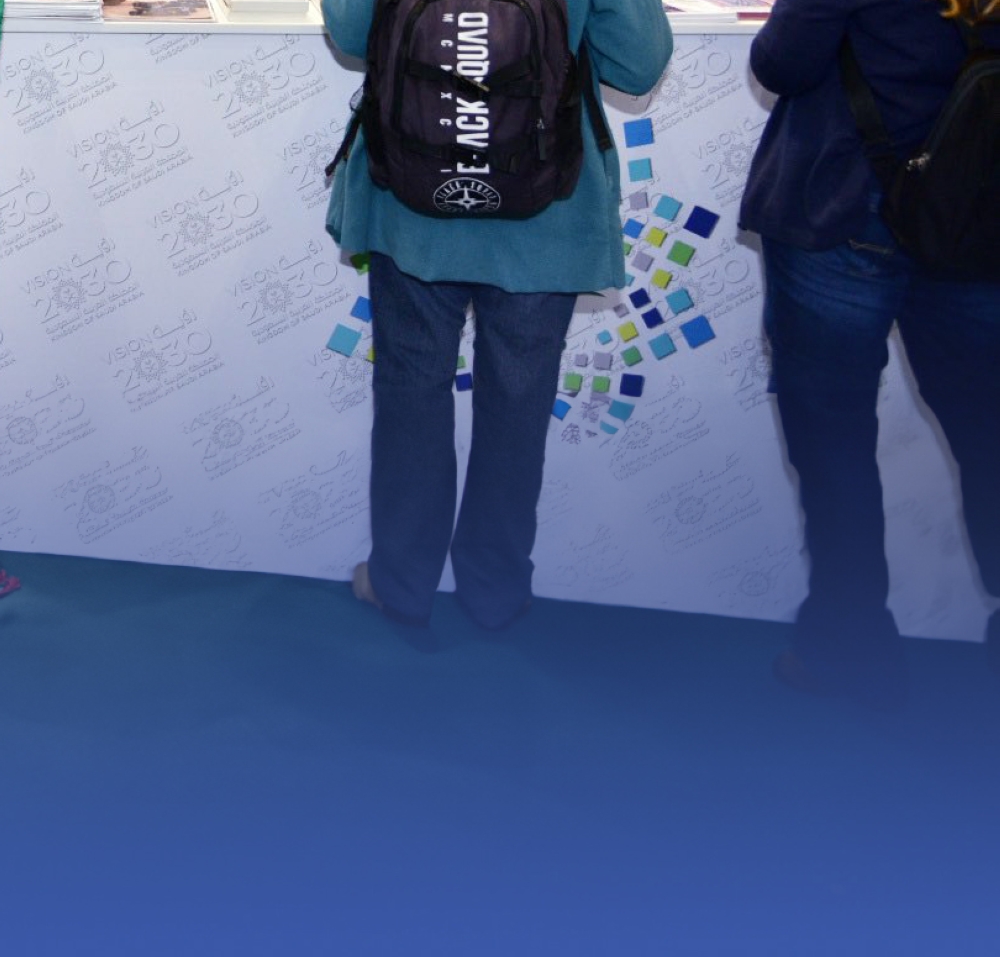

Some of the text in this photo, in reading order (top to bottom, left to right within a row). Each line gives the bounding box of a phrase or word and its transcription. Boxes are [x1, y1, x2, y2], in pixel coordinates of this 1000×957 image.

[456, 12, 490, 83] QUAD
[204, 56, 254, 88] VISION
[68, 127, 119, 159] VISION
[278, 129, 329, 161] VISION
[692, 127, 744, 159] VISION
[147, 197, 198, 229] VISION
[20, 263, 70, 295] VISION
[227, 265, 278, 297] VISION
[101, 335, 152, 367] VISION
[306, 347, 332, 367] VIS
[718, 338, 756, 366] VISIO
